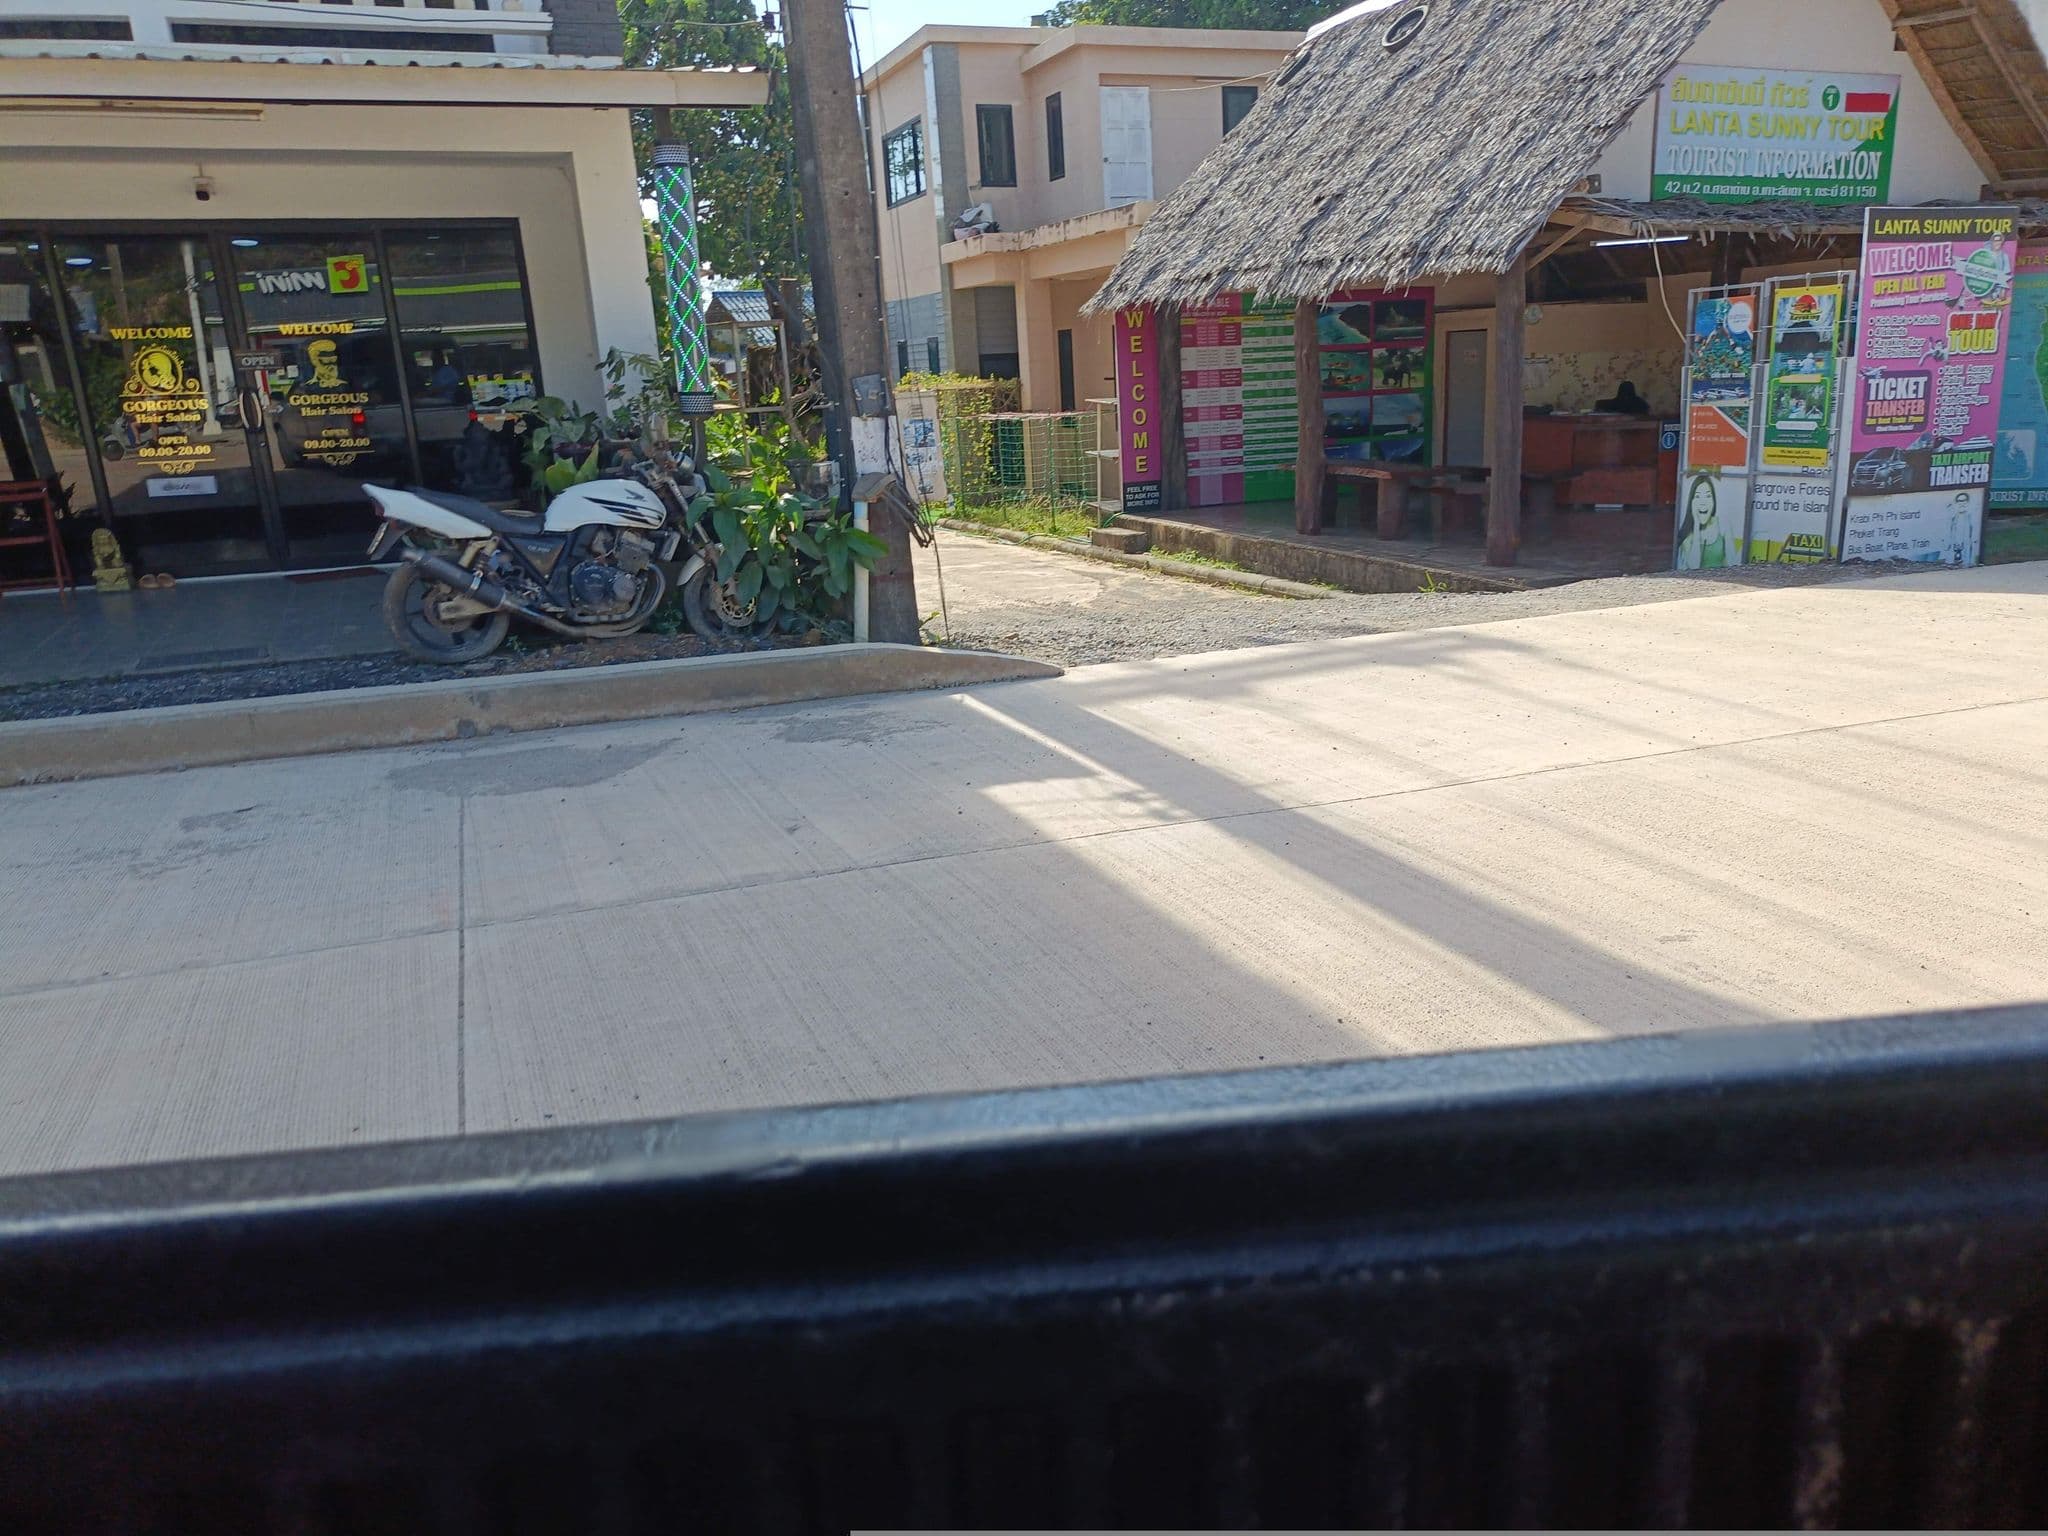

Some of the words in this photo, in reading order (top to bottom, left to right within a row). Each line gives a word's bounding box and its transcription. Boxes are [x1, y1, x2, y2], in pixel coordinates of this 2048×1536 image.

[1670, 109, 1745, 137] LANTA
[1749, 112, 1822, 138] SUNNY
[1829, 116, 1886, 141] TOUR
[1667, 145, 1749, 176] TOURIST
[1751, 149, 1882, 180] INFORMATION
[1664, 181, 1680, 193] 42
[1840, 185, 1877, 197] 81150
[1874, 219, 1921, 235] LANTA
[1923, 219, 1974, 235] SUNNY
[1974, 218, 2013, 234] TOUR
[1870, 243, 1950, 275] WELCOME
[1902, 277, 1919, 293] ALL
[110, 327, 192, 340] WELCOME
[279, 323, 354, 335] WELCOME
[1948, 329, 1998, 352] TOUR
[242, 356, 275, 366] OPEN
[1126, 311, 1149, 473] WELCOME
[1867, 376, 1928, 401] TICKET
[123, 399, 209, 412] GORGEOUS
[289, 392, 369, 406] GORGEOUS
[302, 407, 327, 416] Hair
[329, 406, 362, 415] Salon
[1866, 400, 1925, 417] TRANSFER
[136, 413, 163, 424] Hair
[166, 412, 201, 423] Salon
[1929, 464, 1989, 486] TRANSFER
[1753, 483, 1796, 497] angrove
[1783, 500, 1799, 512] the
[1791, 534, 1823, 548] TAXI
